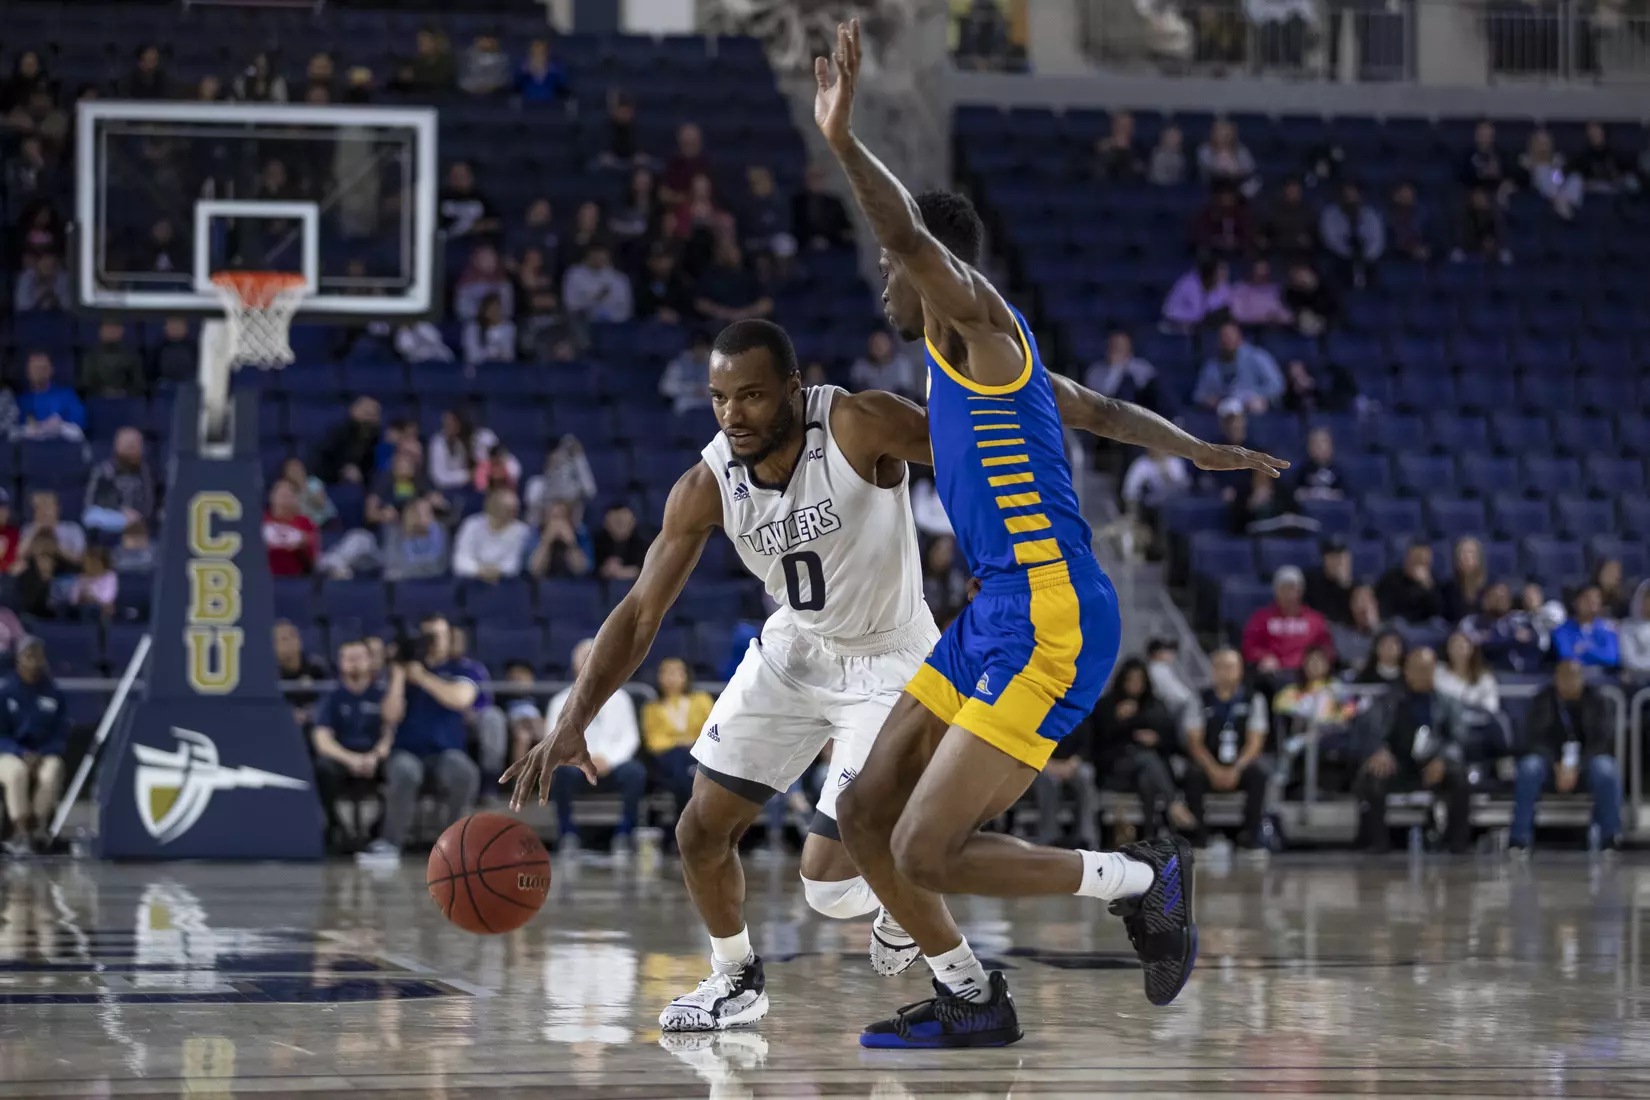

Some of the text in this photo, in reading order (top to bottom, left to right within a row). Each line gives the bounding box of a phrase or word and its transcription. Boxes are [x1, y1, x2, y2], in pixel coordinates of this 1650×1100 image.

[806, 447, 823, 461] AC
[185, 491, 243, 694] CBU
[781, 551, 825, 611] 0
